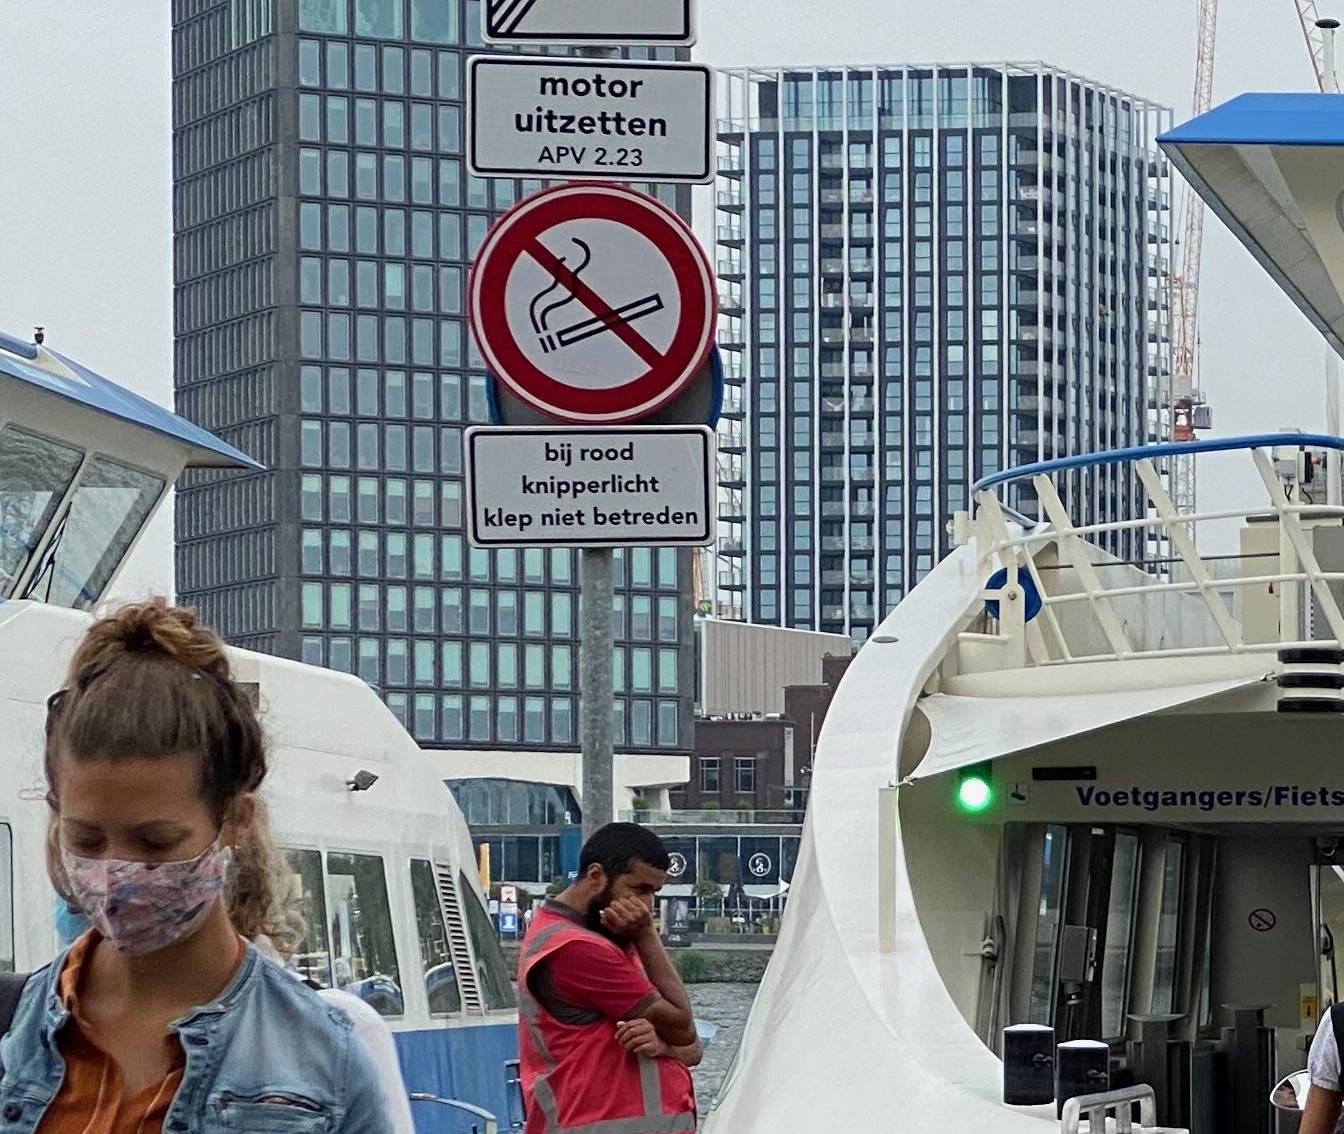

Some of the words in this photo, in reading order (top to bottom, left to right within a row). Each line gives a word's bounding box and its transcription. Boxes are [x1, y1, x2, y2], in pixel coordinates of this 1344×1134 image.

[540, 74, 643, 98] motor
[514, 106, 667, 137] uitzetten
[538, 146, 586, 165] APV
[595, 147, 642, 167] 2.23
[544, 442, 572, 466] bij
[580, 441, 634, 461] rood
[522, 474, 659, 498] knipperlicht
[484, 508, 532, 531] klep
[541, 508, 585, 526] niet
[593, 506, 698, 525] betreden
